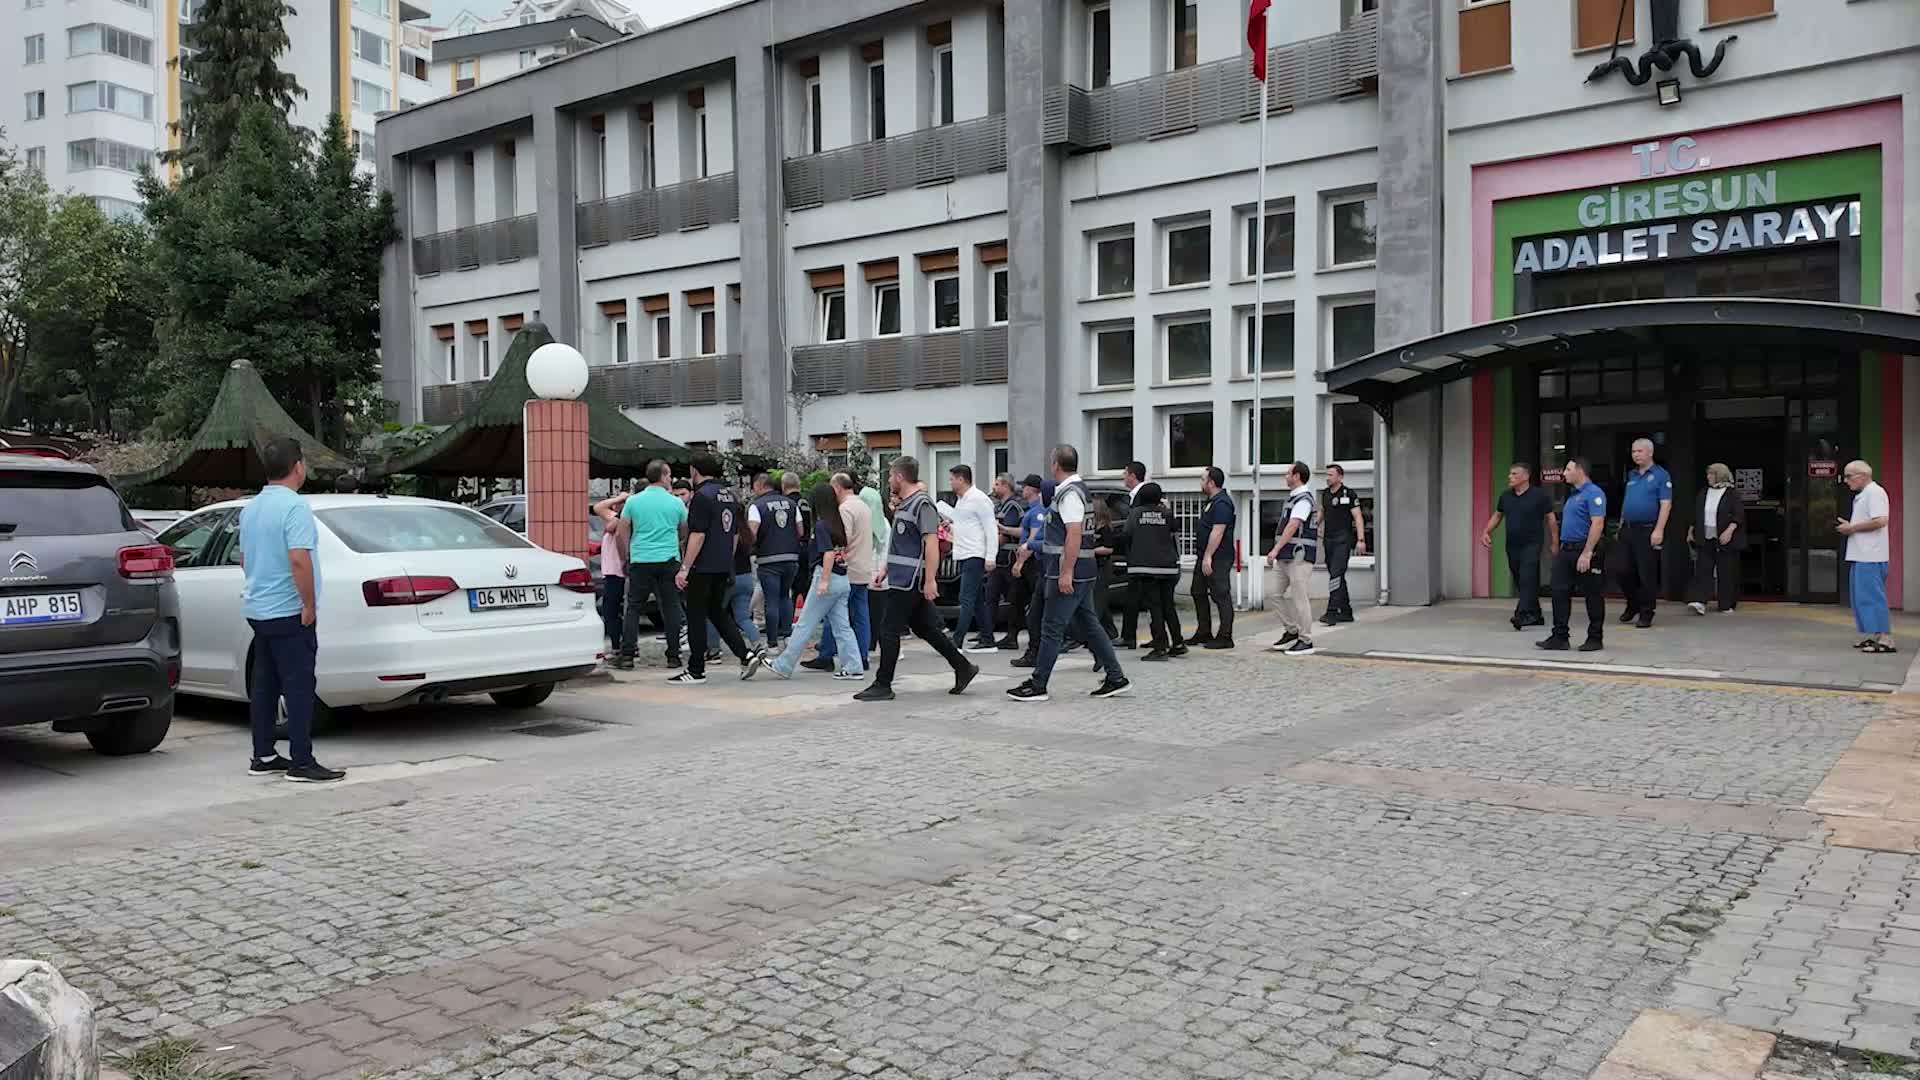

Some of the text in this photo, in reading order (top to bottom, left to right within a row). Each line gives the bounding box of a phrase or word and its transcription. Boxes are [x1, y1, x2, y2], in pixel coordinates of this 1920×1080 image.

[1632, 136, 1711, 176] T.C.
[1578, 170, 1777, 228] GİRESUN
[1513, 200, 1861, 274] ADALET SARAYI
[6, 595, 78, 616] AHP 815
[478, 587, 545, 605] 06 MNH 16
